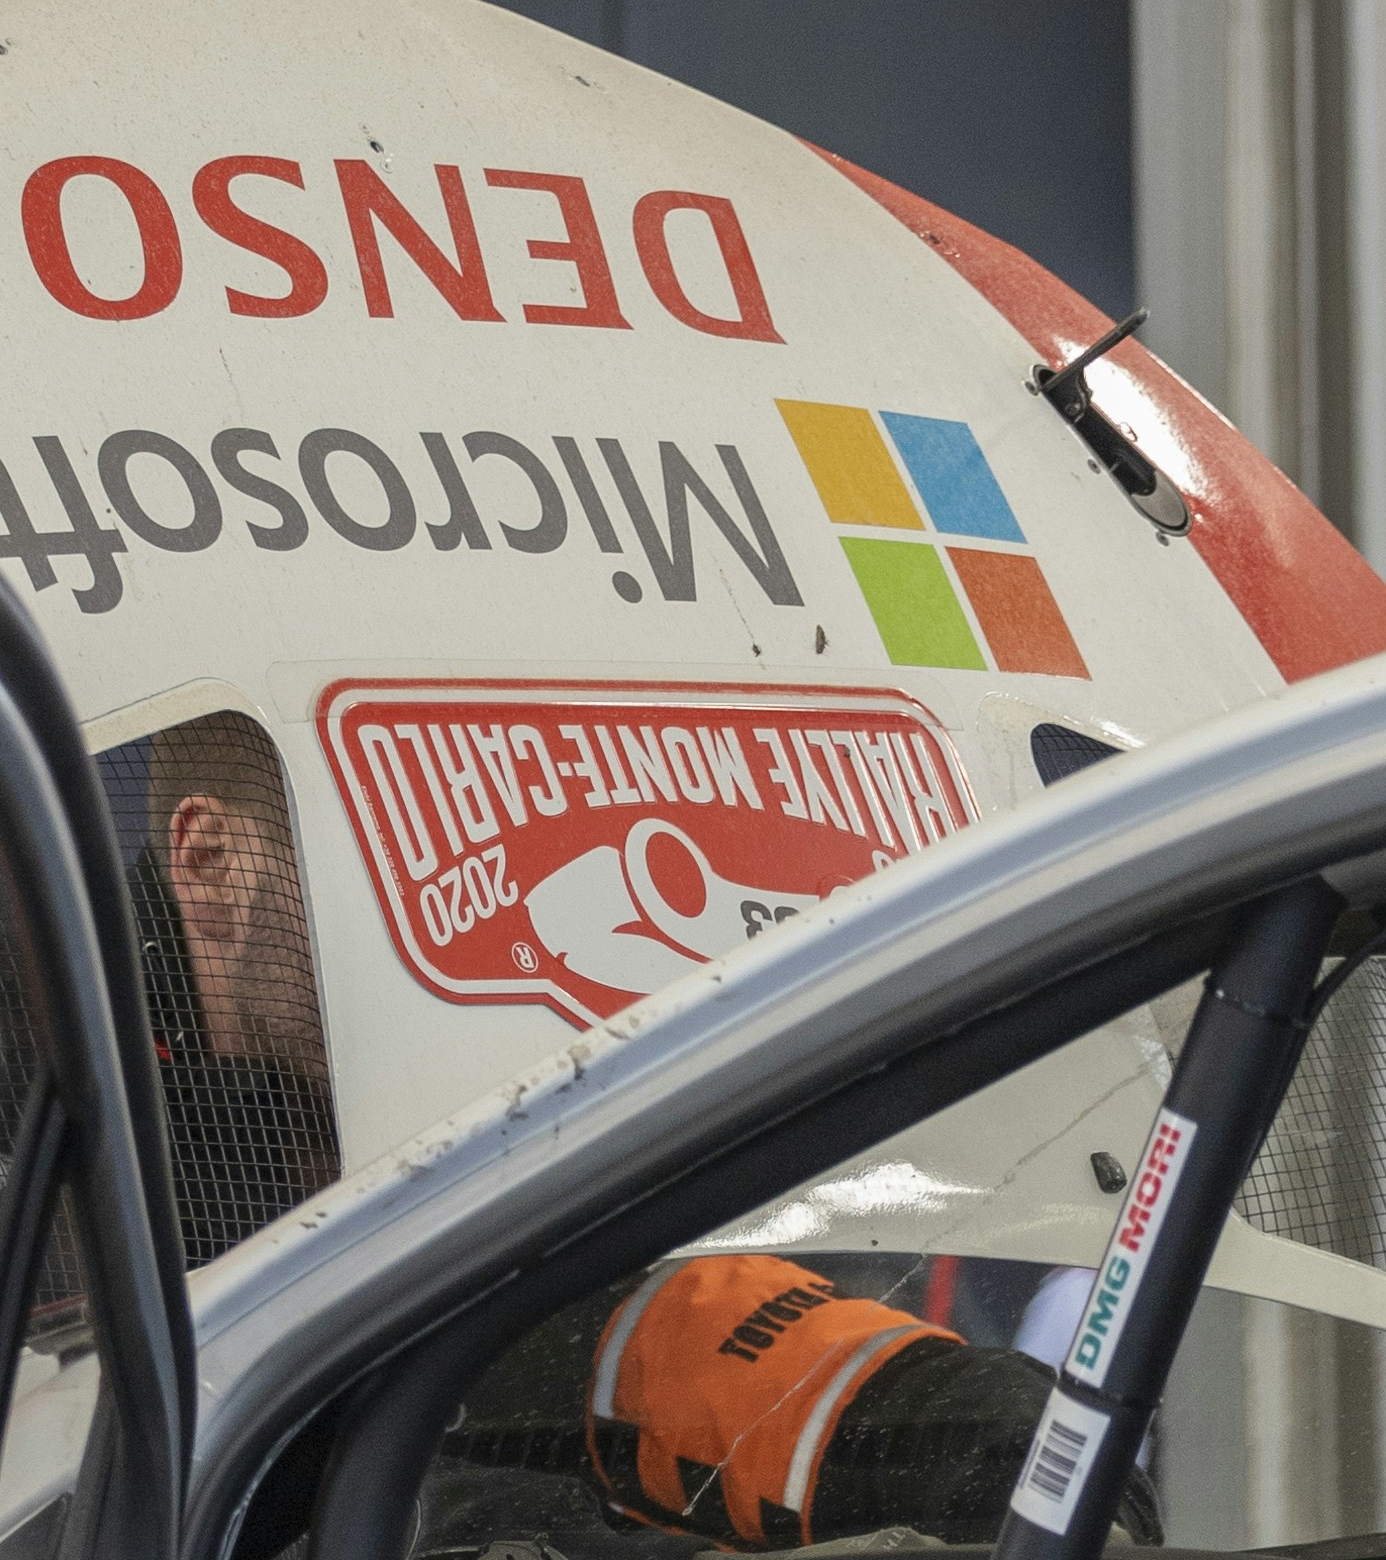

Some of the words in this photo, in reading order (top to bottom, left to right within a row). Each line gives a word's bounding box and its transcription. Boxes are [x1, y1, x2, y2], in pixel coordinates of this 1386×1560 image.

[19, 152, 788, 345] DENSO
[357, 722, 764, 884] MONTE-CARLO
[752, 725, 946, 869] RALLYE
[417, 840, 519, 947] 2020
[1073, 1254, 1133, 1372] DMG
[1117, 1121, 1183, 1253] MORI
